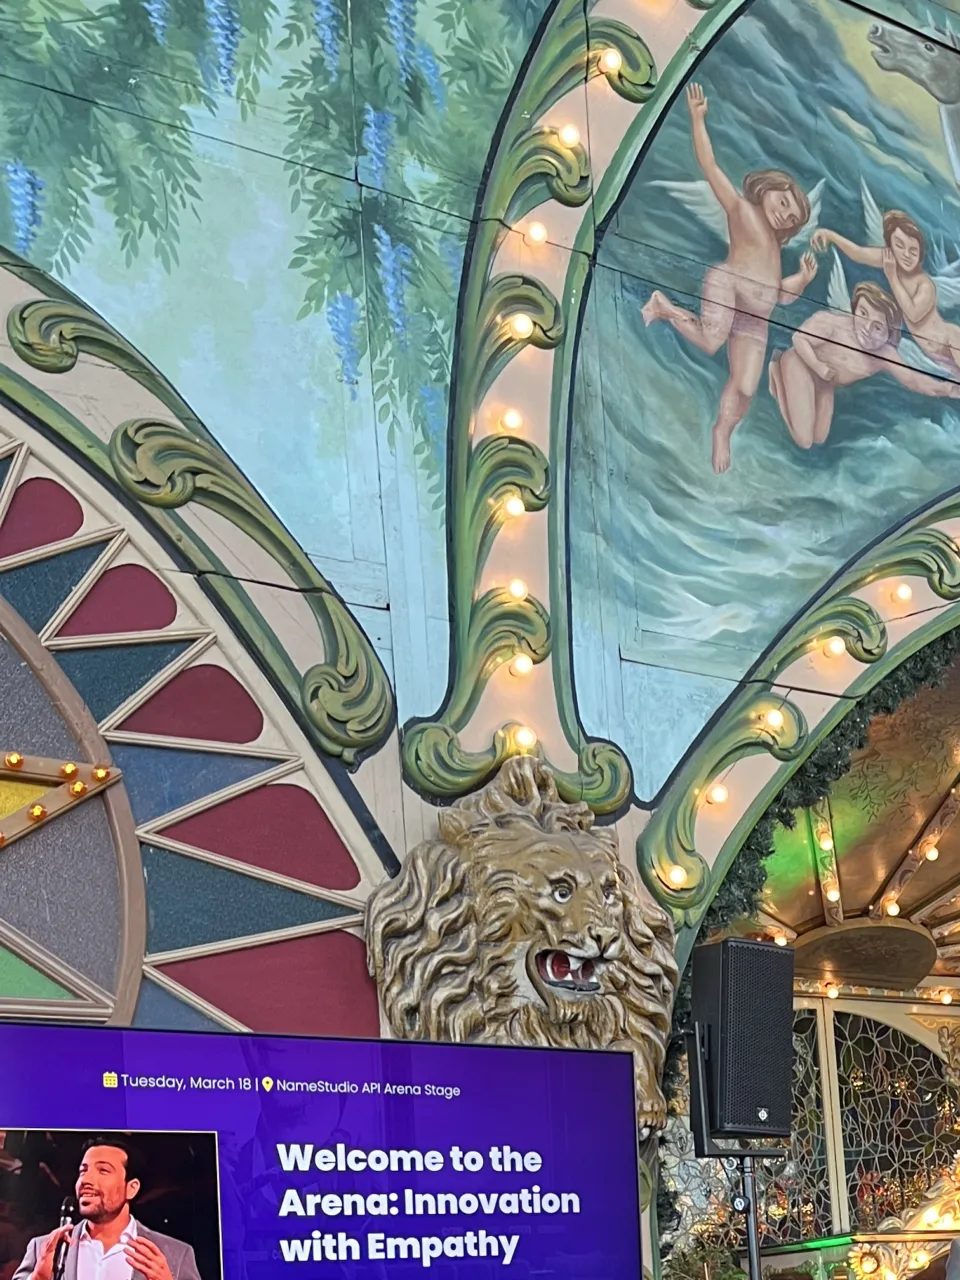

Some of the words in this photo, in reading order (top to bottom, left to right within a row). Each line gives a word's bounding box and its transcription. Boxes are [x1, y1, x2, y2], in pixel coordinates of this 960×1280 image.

[121, 1074, 186, 1091] Tuesday,
[190, 1076, 235, 1089] March
[238, 1077, 252, 1090] 18
[276, 1079, 359, 1094] NameStudio
[362, 1082, 381, 1094] API
[384, 1083, 421, 1095] Arena
[425, 1084, 461, 1100] Stage
[276, 1143, 444, 1172] Welcome
[450, 1145, 484, 1172] to
[489, 1145, 542, 1172] the
[278, 1189, 399, 1217] Arena:
[404, 1185, 581, 1215] Innovation
[280, 1230, 360, 1262] with
[367, 1230, 520, 1267] Empathy
